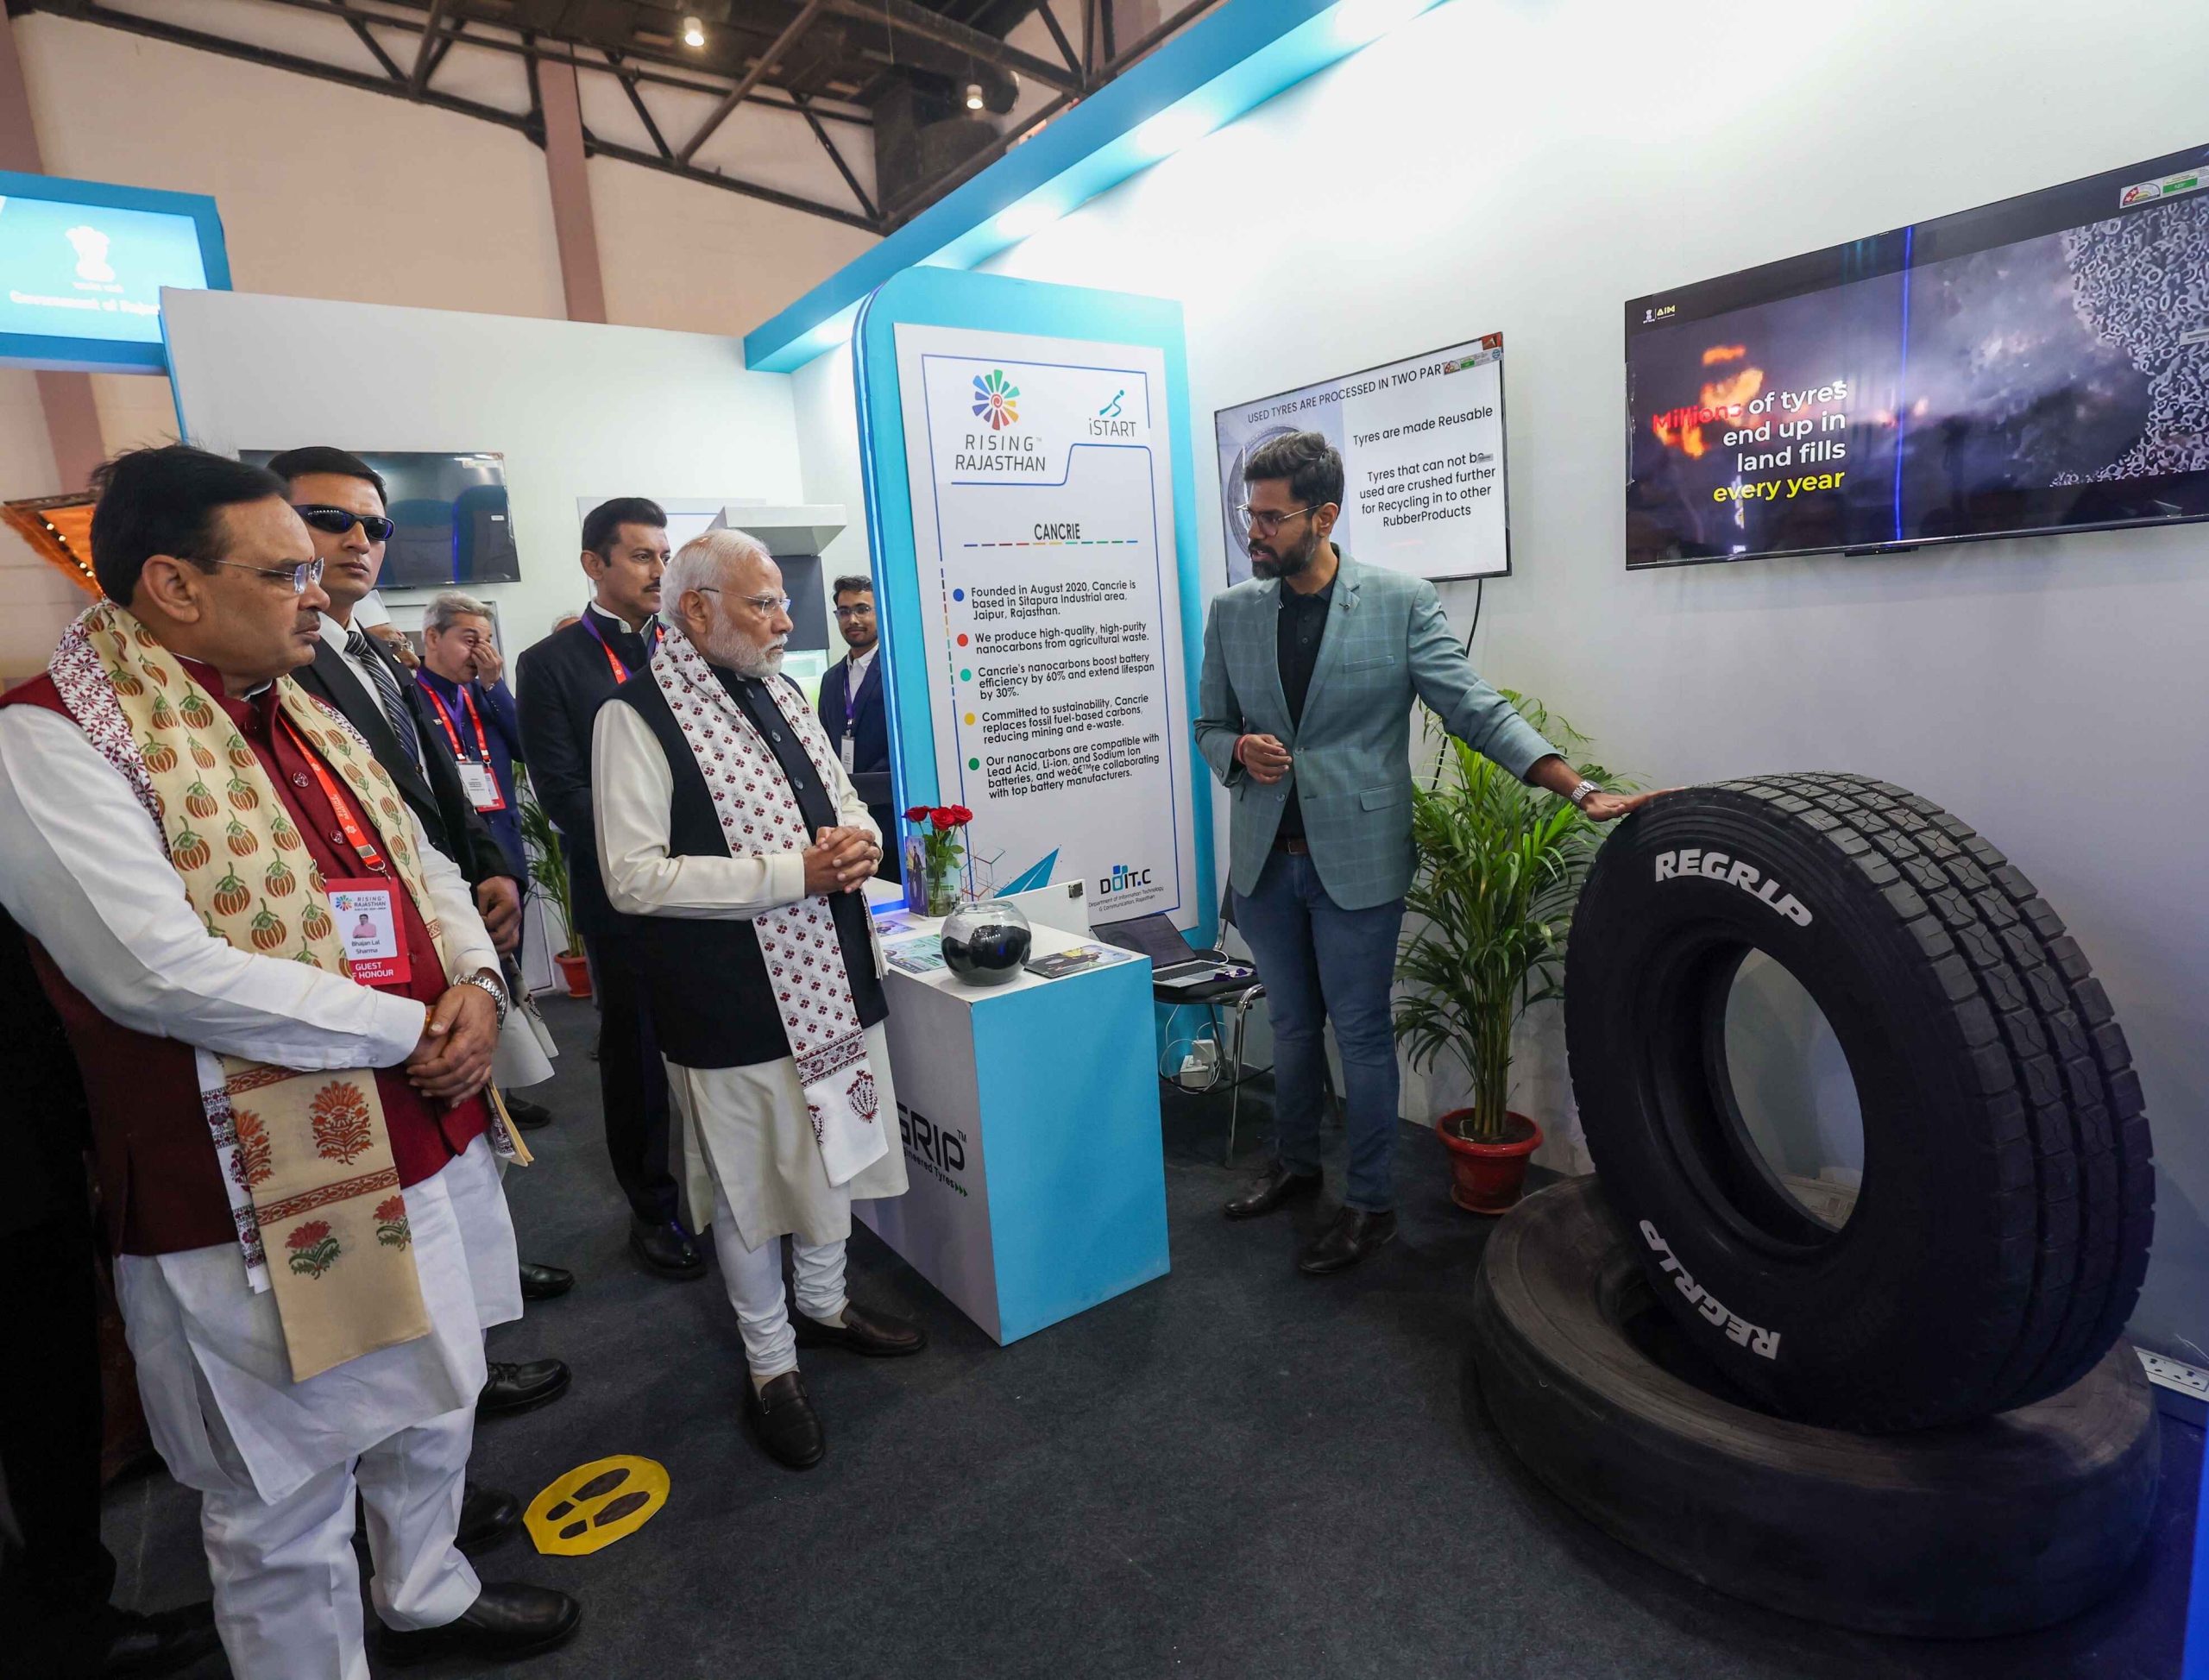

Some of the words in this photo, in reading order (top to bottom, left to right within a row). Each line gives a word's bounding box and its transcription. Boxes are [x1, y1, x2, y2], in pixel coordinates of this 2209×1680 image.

[1248, 411, 1269, 424] USED
[1271, 403, 1298, 418] TYRES
[1300, 397, 1317, 411] ARE
[1319, 381, 1375, 404] PROCESSED
[1378, 379, 1388, 390] IN
[1391, 371, 1417, 386] TWO
[1652, 403, 1742, 432] Millions
[1749, 392, 1775, 414] of
[1781, 380, 1847, 413] tyres
[1088, 418, 1136, 437] iSTART
[1354, 433, 1380, 446] Tyres
[1382, 429, 1400, 439] are
[1403, 422, 1436, 434] made
[1438, 406, 1493, 426] Reusable
[1723, 421, 1771, 446] end
[1779, 419, 1812, 440] up
[1822, 411, 1845, 431] in
[966, 434, 1034, 451] RISING
[1738, 446, 1791, 472] land
[1799, 439, 1846, 464] fills
[955, 455, 1046, 471] RAJASTHAN
[1368, 469, 1394, 483] Tyres
[1398, 465, 1419, 477] that
[1423, 461, 1444, 472] can
[1447, 456, 1466, 468] not
[1360, 487, 1384, 500] used
[1388, 482, 1405, 494] are
[1407, 475, 1452, 490] crushed
[1456, 467, 1495, 481] further
[1713, 480, 1781, 502] every
[1786, 472, 1845, 498] year
[1362, 503, 1375, 515] for
[1378, 494, 1430, 513] Recycling
[1432, 493, 1443, 503] in
[1445, 490, 1457, 501] to
[1461, 486, 1491, 499] other
[1383, 505, 1471, 527] RubberProducts
[1034, 524, 1080, 540] CANCRIE
[972, 586, 1016, 597] Founded
[1019, 585, 1027, 595] in
[1030, 583, 1063, 595] August
[1066, 582, 1090, 593] 2020,
[1092, 581, 1127, 590] Cancrie
[1130, 580, 1136, 589] is
[972, 599, 1004, 608] based
[1007, 598, 1016, 607] in
[1019, 596, 1058, 610] Sitapura
[1060, 593, 1101, 604] Industrial
[1104, 593, 1127, 601] area,
[973, 609, 1007, 621] Jaipur,
[1010, 606, 1060, 620] Rajasthan.
[975, 633, 991, 643] We
[995, 631, 1036, 644] produce
[1040, 626, 1098, 639] high-quality,
[1100, 622, 1146, 636] high-purity
[976, 641, 1042, 654] nanocarbons
[1045, 639, 1066, 649] from
[1069, 634, 1119, 648] agricultural
[1123, 632, 1149, 642] waste.
[979, 664, 1025, 677] Cancrie's
[1028, 658, 1090, 672] nanocarbons
[1093, 656, 1117, 666] boost
[1119, 654, 1149, 664] battery
[979, 676, 1028, 689] efficiency
[1031, 674, 1043, 684] by
[1047, 671, 1066, 682] 60%
[1068, 670, 1086, 680] and
[1089, 666, 1119, 677] extend
[1122, 664, 1155, 675] lifespan
[980, 690, 992, 701] by
[996, 688, 1019, 697] 30%.
[982, 708, 1037, 722] Committed
[1040, 706, 1049, 715] to
[1053, 699, 1112, 714] sustainability,
[1115, 695, 1149, 706] Cancrie
[983, 720, 1027, 734] replaces
[1029, 716, 1051, 727] fossil
[1054, 711, 1104, 724] fuel-based
[1106, 707, 1142, 716] carbons,
[984, 731, 1029, 744] reducing
[1032, 727, 1063, 739] mining
[1067, 723, 1084, 733] and
[1087, 719, 1123, 730] e-waste.
[986, 756, 1004, 766] Our
[1007, 746, 1071, 764] nanocarbons
[1073, 744, 1088, 753] are
[1091, 736, 1140, 752] compatible
[1142, 733, 1159, 744] with
[987, 767, 1011, 777] Lead
[1015, 763, 1040, 774] Acid,
[1042, 758, 1070, 769] Li-ion,
[1073, 755, 1091, 764] and
[1093, 749, 1124, 761] Sodium
[1127, 747, 1141, 756] Ion
[989, 776, 1033, 788] batteries,
[1036, 771, 1054, 781] and
[1104, 754, 1159, 771] collaborating
[989, 788, 1009, 799] with
[1011, 784, 1028, 796] top
[1030, 781, 1064, 793] battery
[1067, 769, 1132, 786] manufacturers.
[1089, 897, 1112, 907] Department
[1118, 891, 1142, 900] Information
[1655, 848, 1813, 927] REGRIP
[356, 962, 381, 971] GUEST
[359, 970, 393, 979] HONOUR
[897, 1101, 965, 1172] GRIP
[934, 1167, 953, 1187] Tyres
[1639, 1220, 1781, 1360] REGRIP
